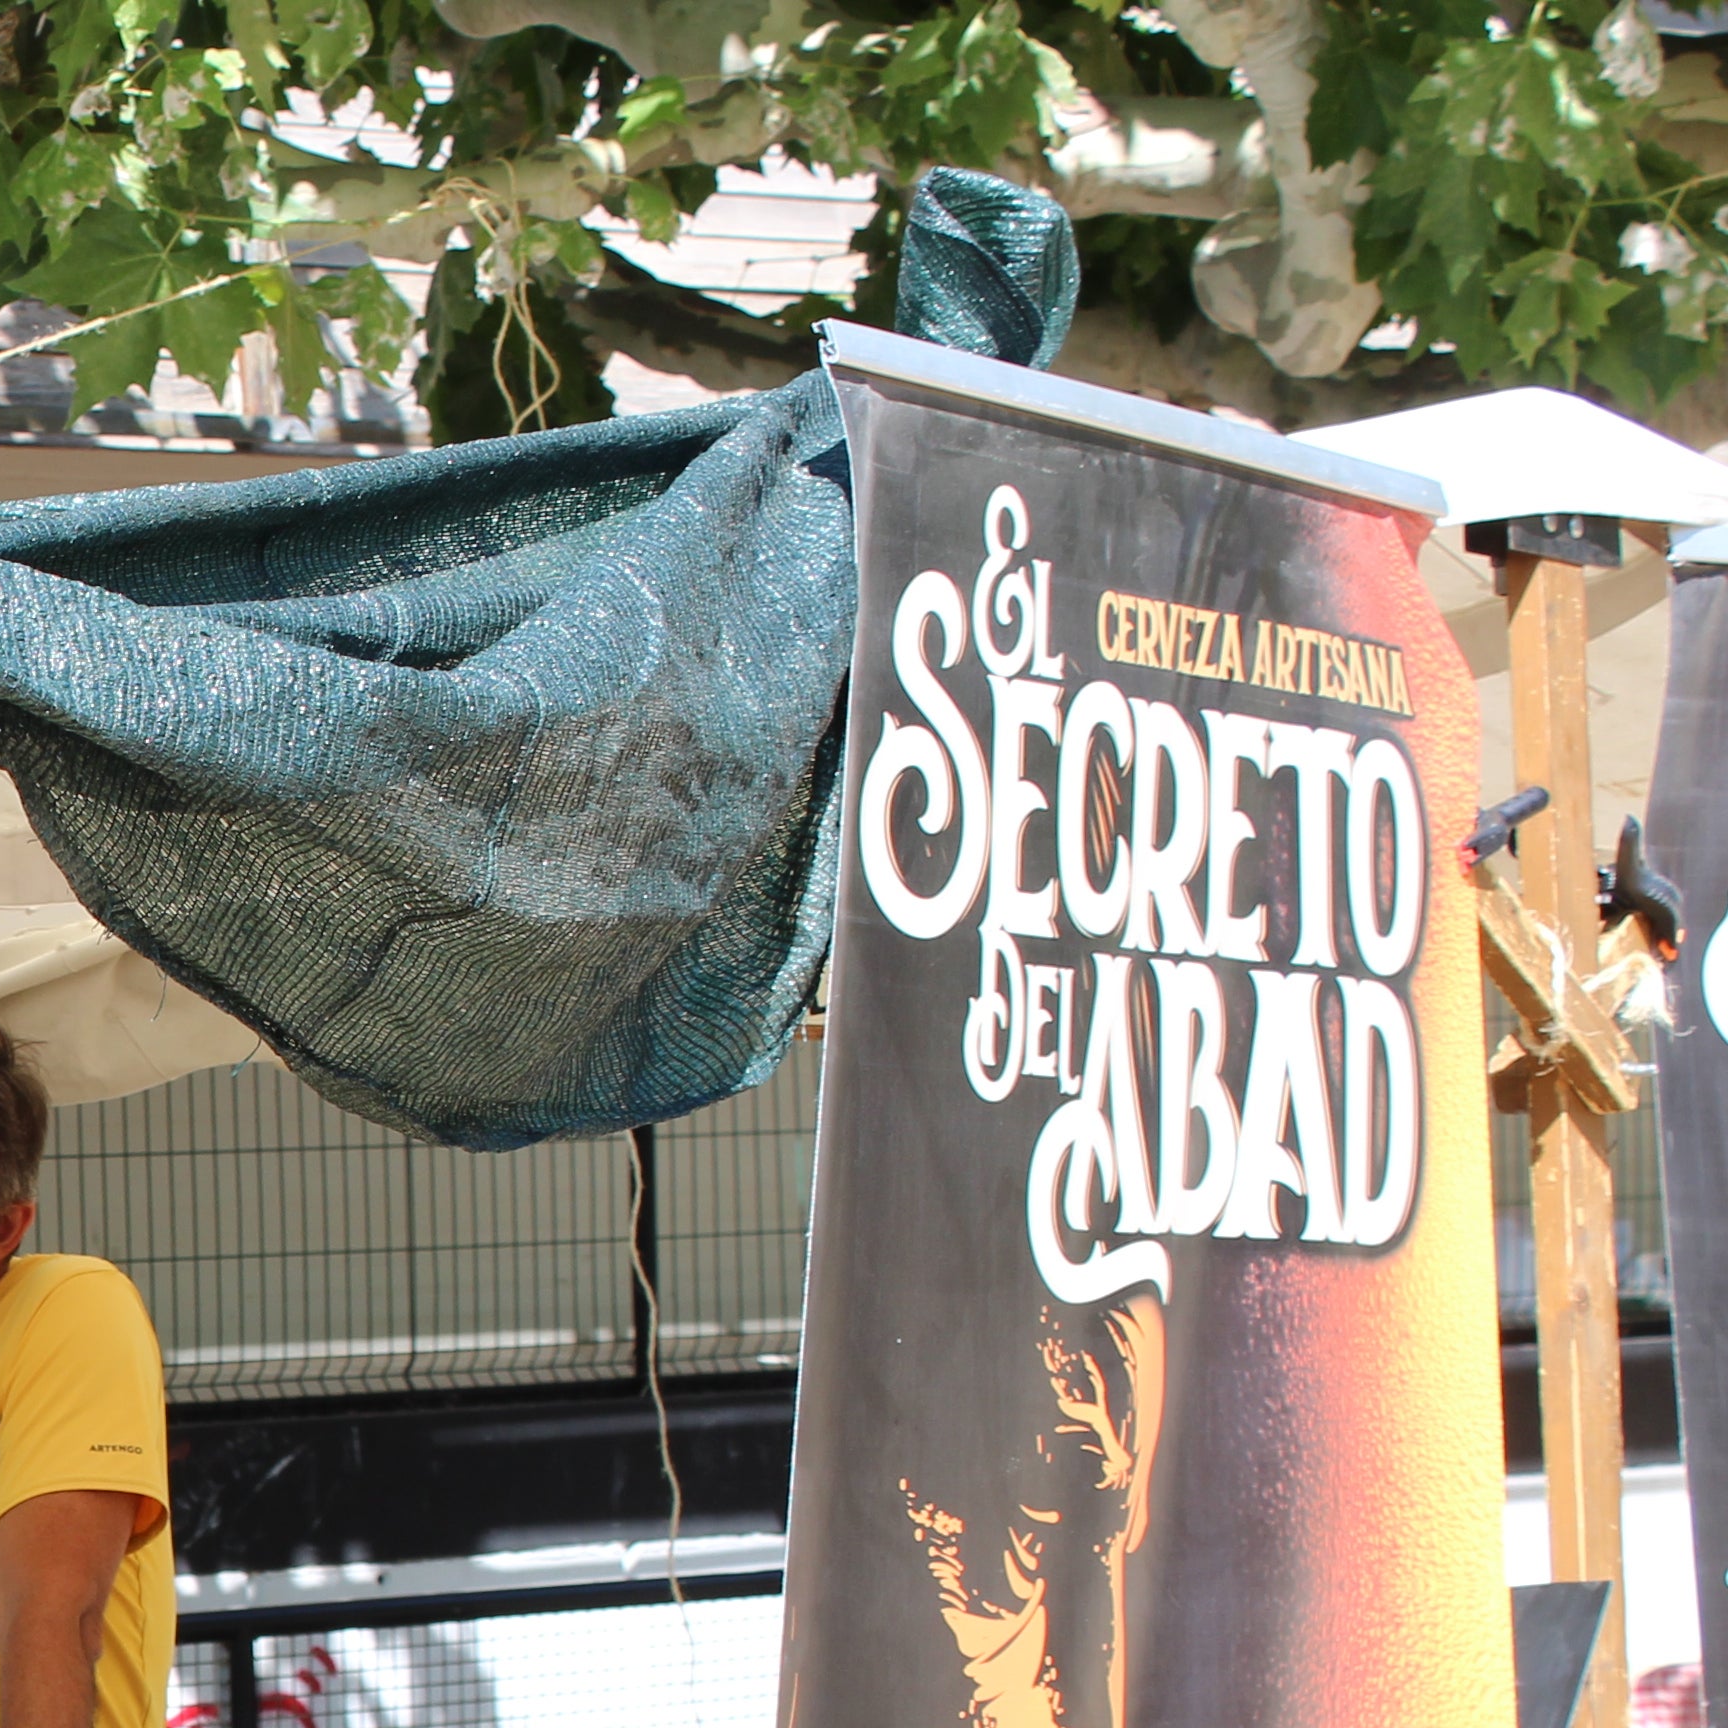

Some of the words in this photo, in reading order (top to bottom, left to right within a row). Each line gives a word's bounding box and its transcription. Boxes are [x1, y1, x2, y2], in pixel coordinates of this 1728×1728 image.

[972, 483, 1065, 680] EL
[1096, 589, 1245, 685] CERVEZA
[1250, 619, 1415, 719] ARTESANA
[858, 569, 1426, 978] SECRETO
[963, 923, 1082, 1103] DEL
[1026, 954, 1422, 1306] ABAD
[89, 1445, 143, 1455] ARTENGO
